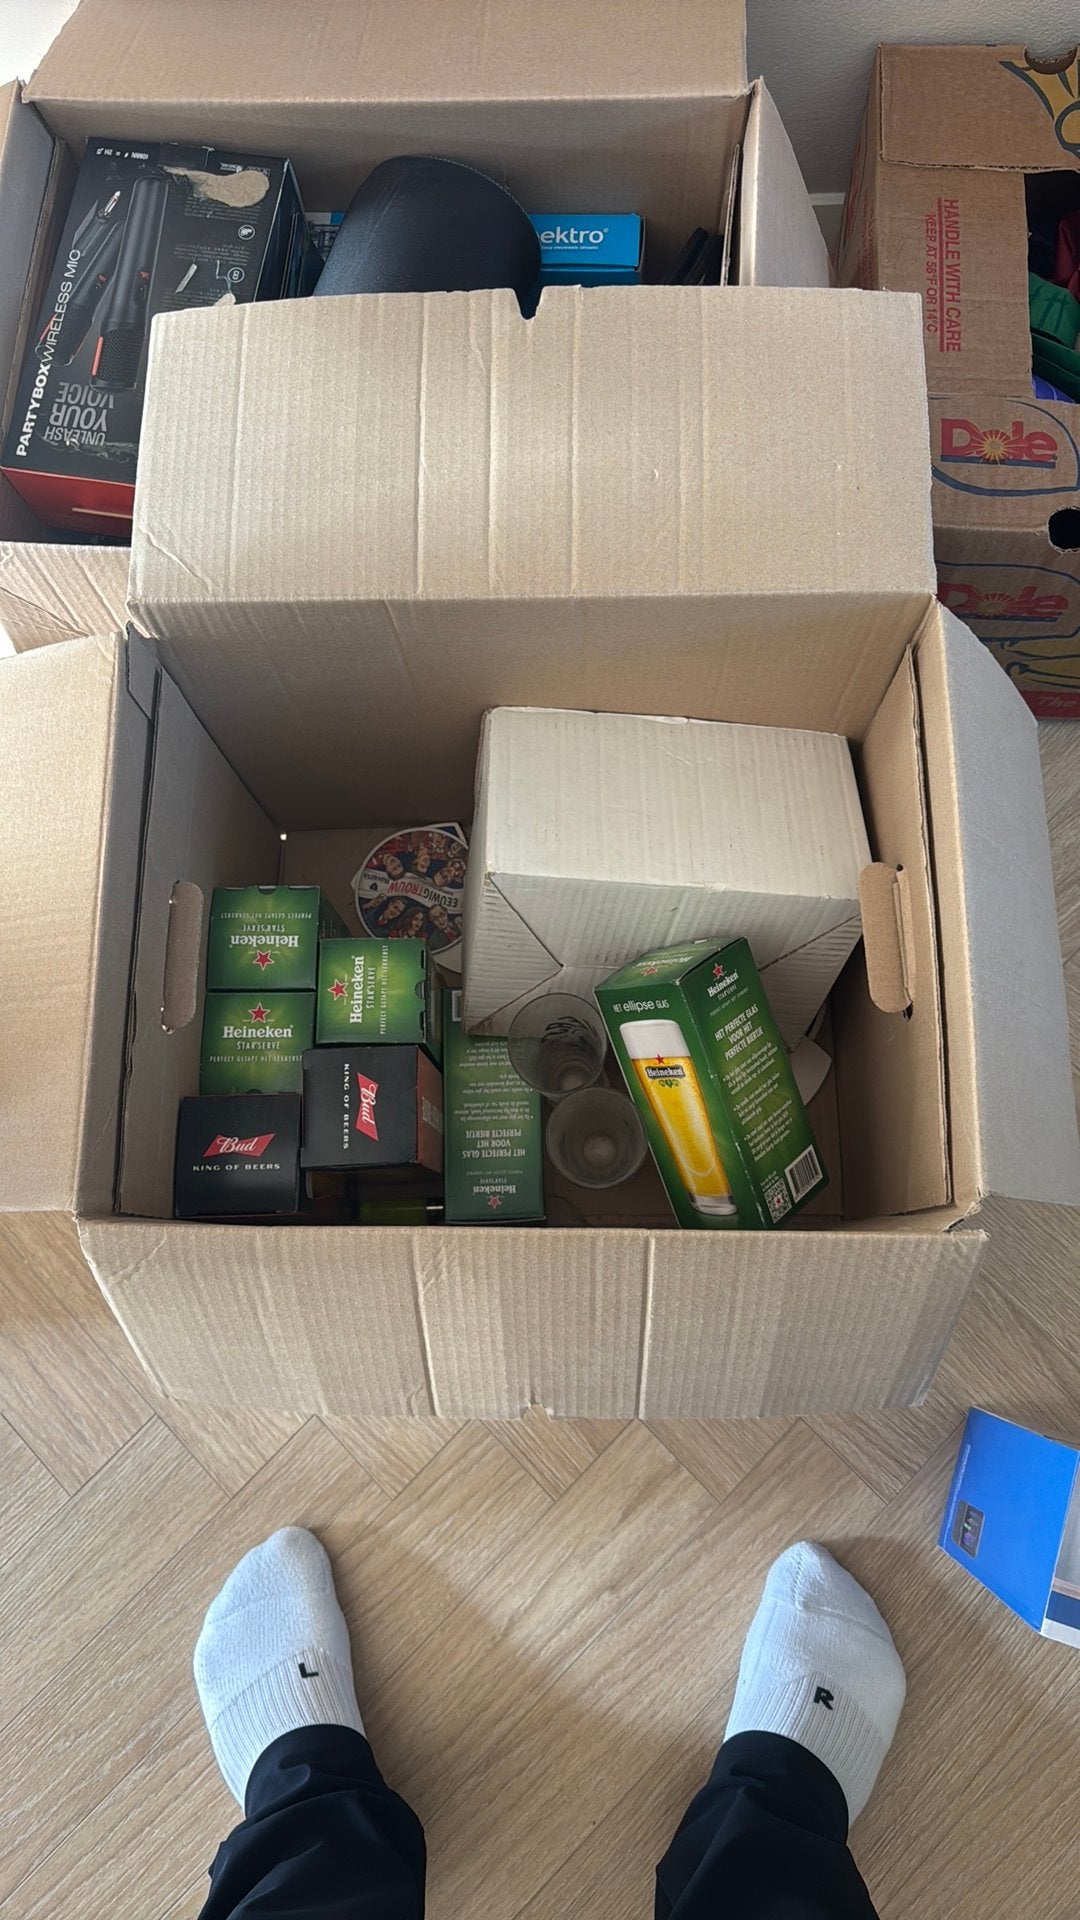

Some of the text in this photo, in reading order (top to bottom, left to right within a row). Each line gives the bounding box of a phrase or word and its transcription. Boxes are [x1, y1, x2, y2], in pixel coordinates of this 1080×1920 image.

[925, 214, 937, 242] KEEP
[926, 244, 937, 259] AT
[943, 199, 961, 352] HANDLE WITH CARE
[926, 288, 938, 305] OR
[926, 308, 938, 333] 14°C
[16, 250, 81, 457] PARTYBOX WIRELESS MIC
[55, 382, 114, 409] VOICE
[49, 403, 108, 431] YOUR
[44, 426, 106, 446] UNLEASH
[940, 417, 1058, 463] Dole
[230, 935, 300, 948] Heineken
[349, 955, 364, 1024] Heineken
[707, 970, 739, 998] Heineken
[613, 999, 670, 1013] HET ellipse GLAS
[222, 1025, 293, 1039] Heineken
[714, 1028, 726, 1041] HET
[724, 1012, 747, 1035] PERFECTE
[745, 1003, 759, 1019] GLAS
[728, 1021, 753, 1044] VOOR HET
[724, 1038, 748, 1061] PERFECTE
[647, 1067, 684, 1078] Heineken
[343, 1094, 350, 1109] OF
[360, 1084, 376, 1125] Bud
[465, 1129, 522, 1138] PERFECTE BIERTJE
[477, 1139, 511, 1148] VOOR HET
[216, 1136, 259, 1153] Bud
[462, 1148, 526, 1158] HET PERFECTE GLAS
[473, 1184, 516, 1194] Heineken
[298, 1662, 319, 1679] L
[813, 1686, 834, 1711] R
